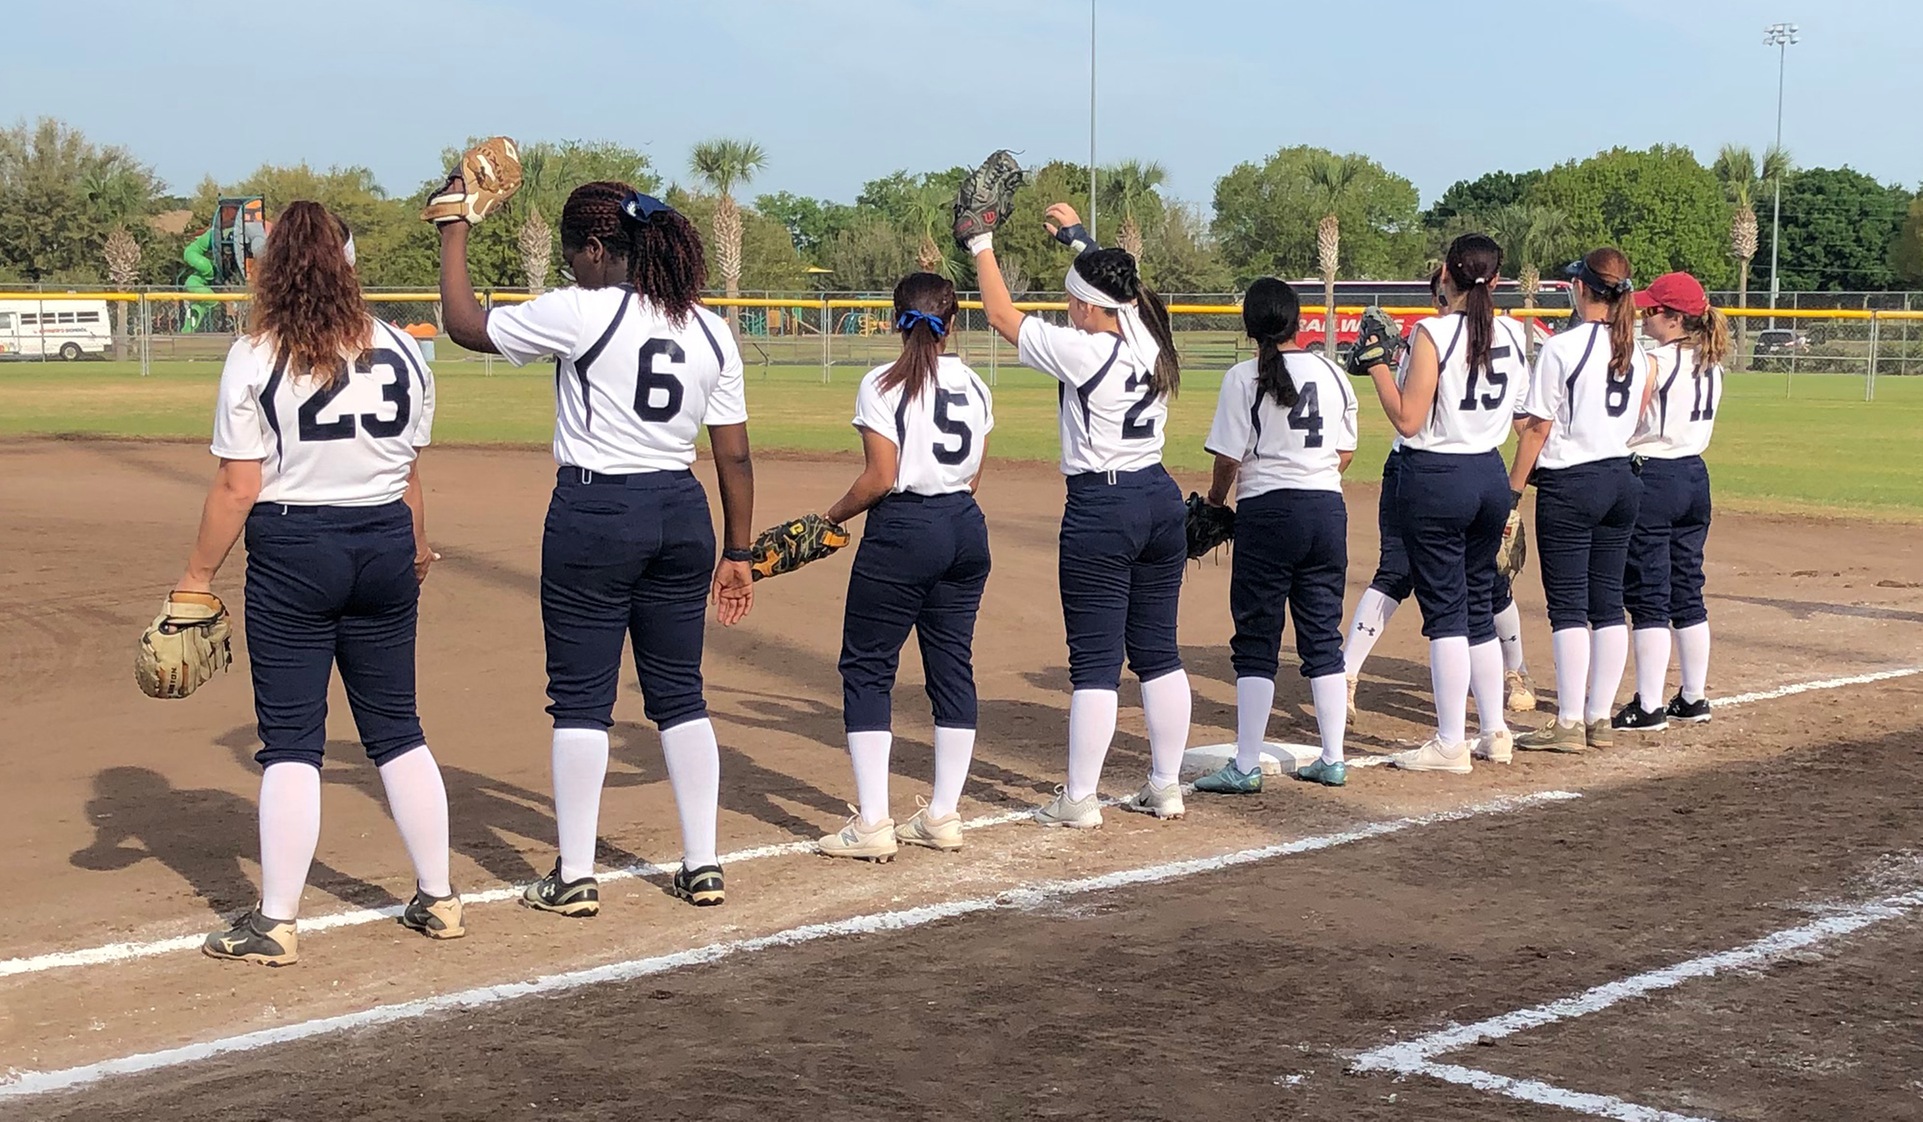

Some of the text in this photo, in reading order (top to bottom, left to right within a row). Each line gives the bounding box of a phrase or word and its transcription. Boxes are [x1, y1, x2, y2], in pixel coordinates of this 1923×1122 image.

[298, 348, 411, 441] 23
[633, 337, 685, 423] 6
[1121, 370, 1160, 440] 2
[1459, 345, 1511, 411] 15
[1605, 360, 1635, 418] 8
[1689, 362, 1714, 422] 11
[932, 387, 973, 466] 5
[1287, 381, 1324, 449] 4
